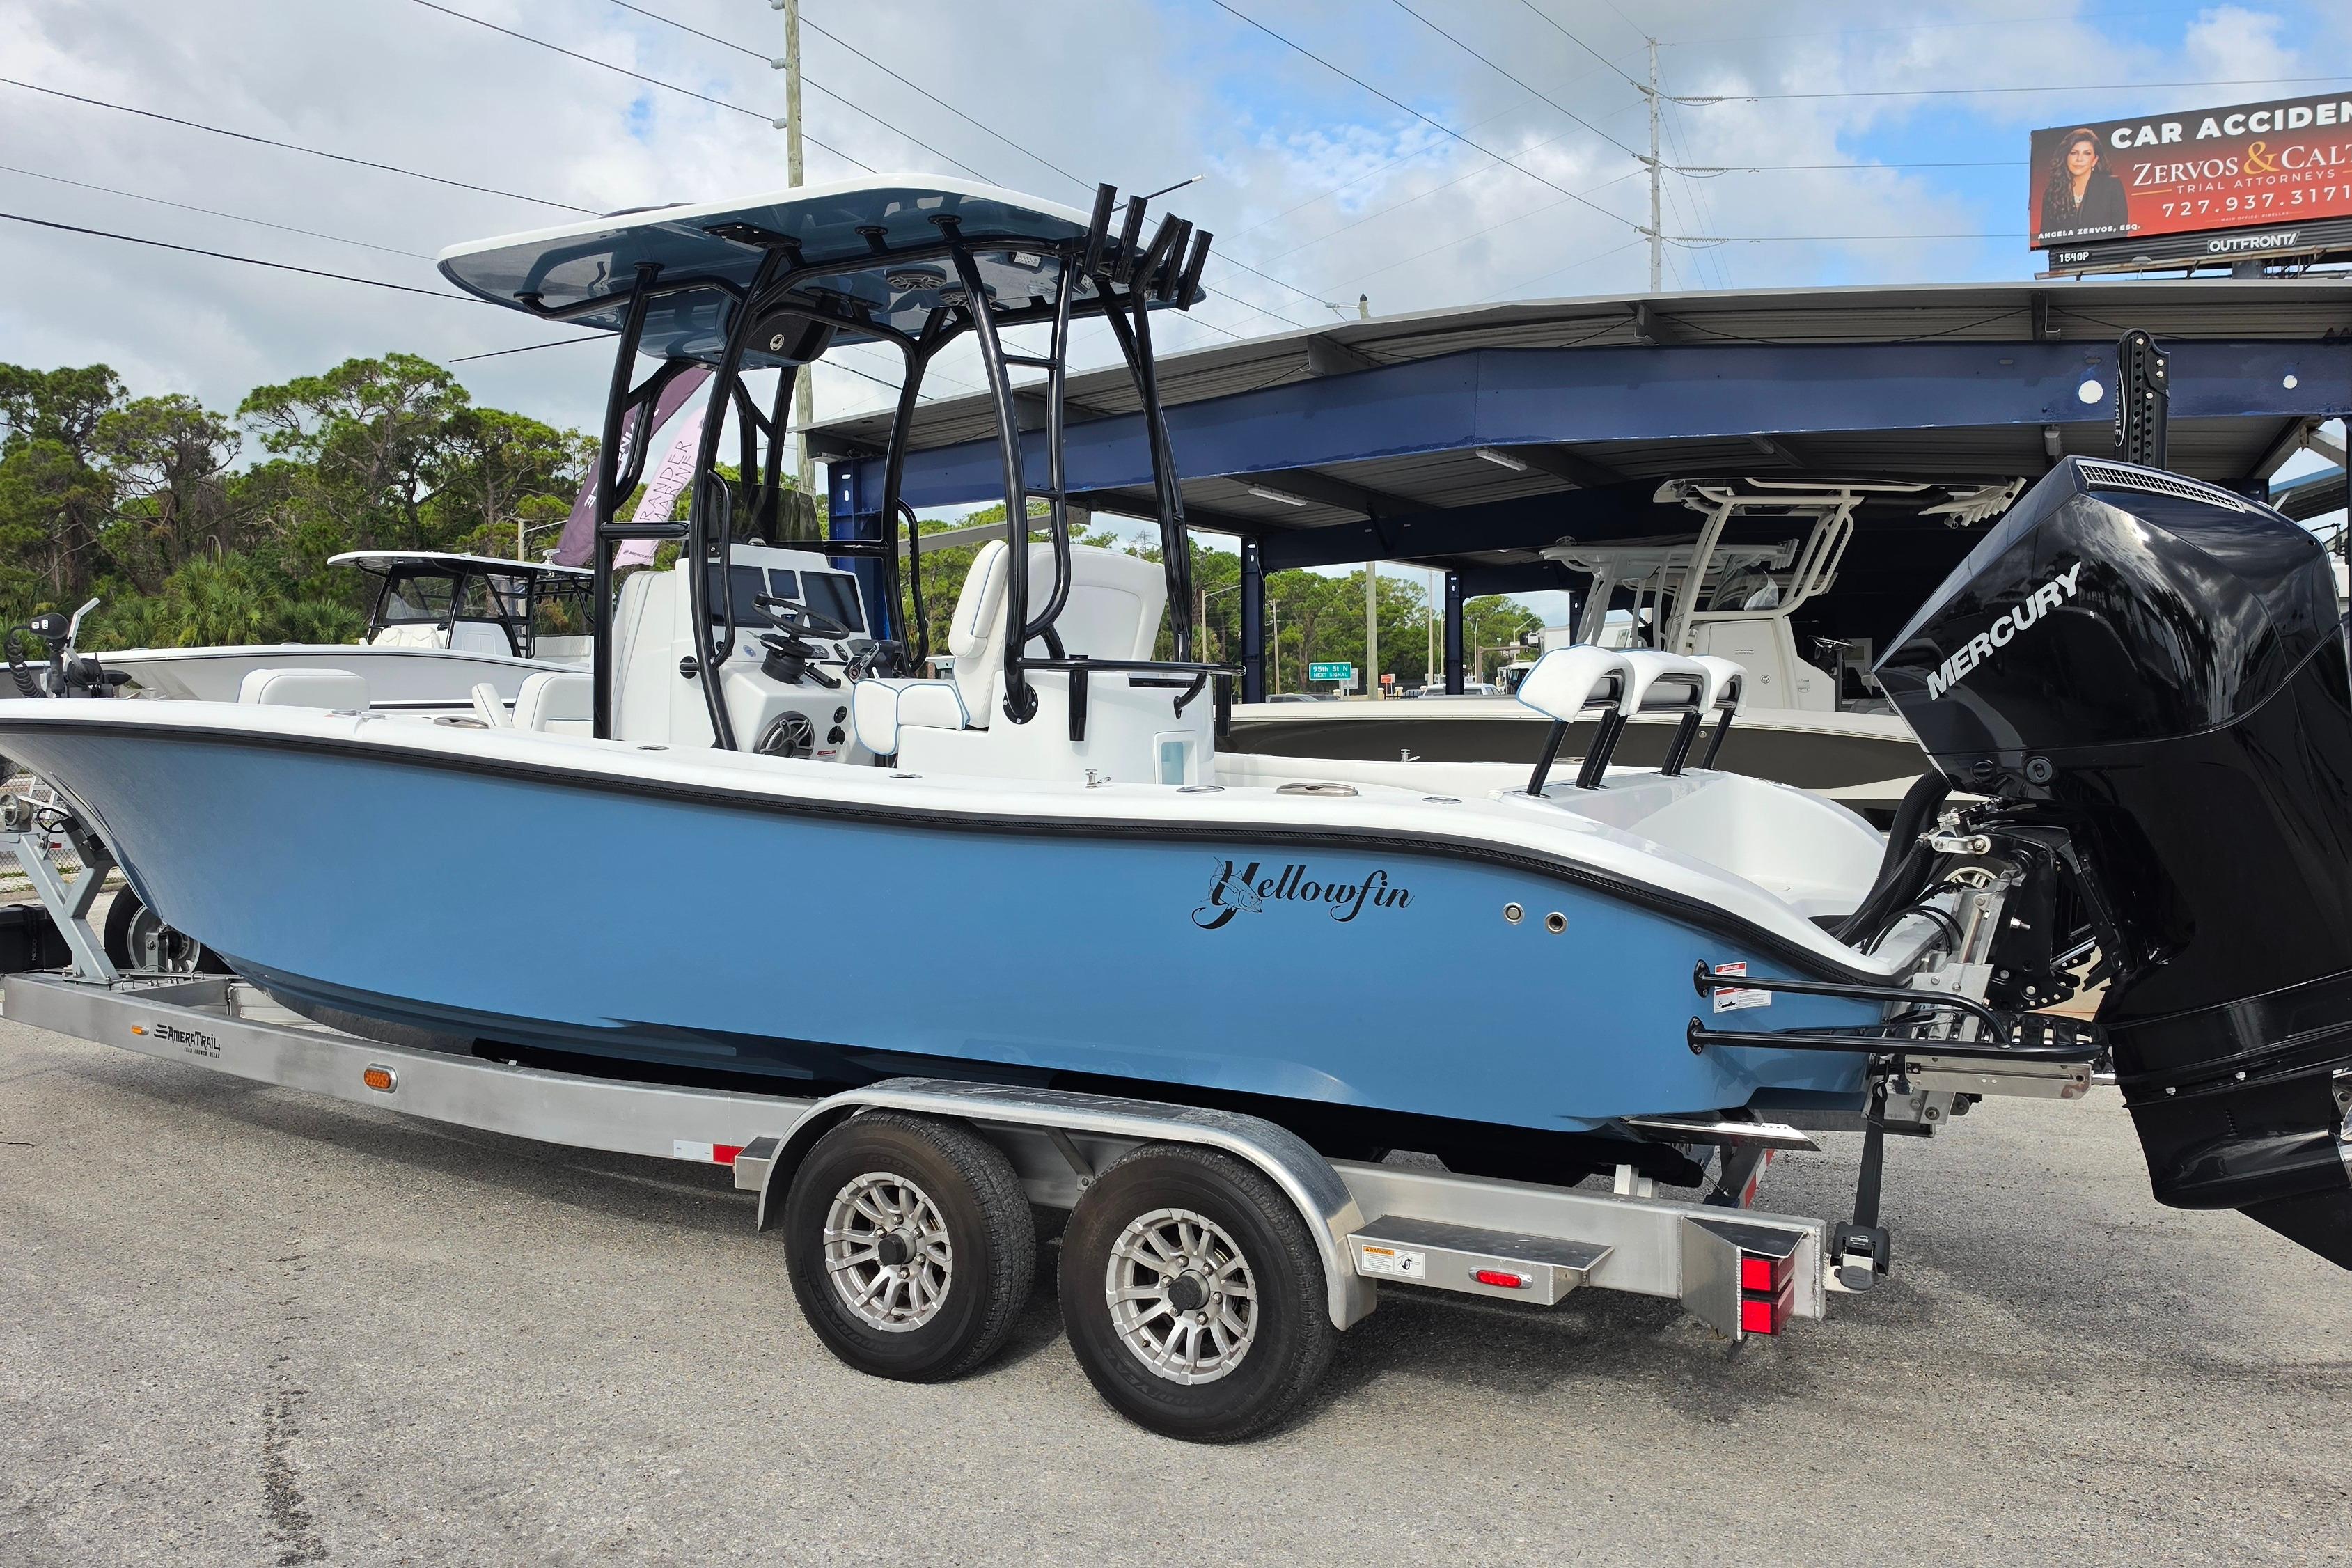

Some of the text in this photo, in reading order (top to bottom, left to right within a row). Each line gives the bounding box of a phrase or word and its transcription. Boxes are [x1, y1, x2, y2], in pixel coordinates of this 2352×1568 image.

[2110, 122, 2183, 149] CAR
[2133, 157, 2239, 187] ZERVOS
[2243, 141, 2280, 175] &
[2177, 169, 2335, 194] TRIAL ATTORNEYS
[2163, 185, 2351, 217] 727.937.3171
[2037, 229, 2074, 240] ANGELA
[2077, 225, 2117, 235] ZERVOS,
[2059, 251, 2090, 263] 1540P
[639, 440, 693, 521] RANDER
[1926, 561, 2082, 701] MERCURY
[1191, 861, 1415, 930] Yellowfin
